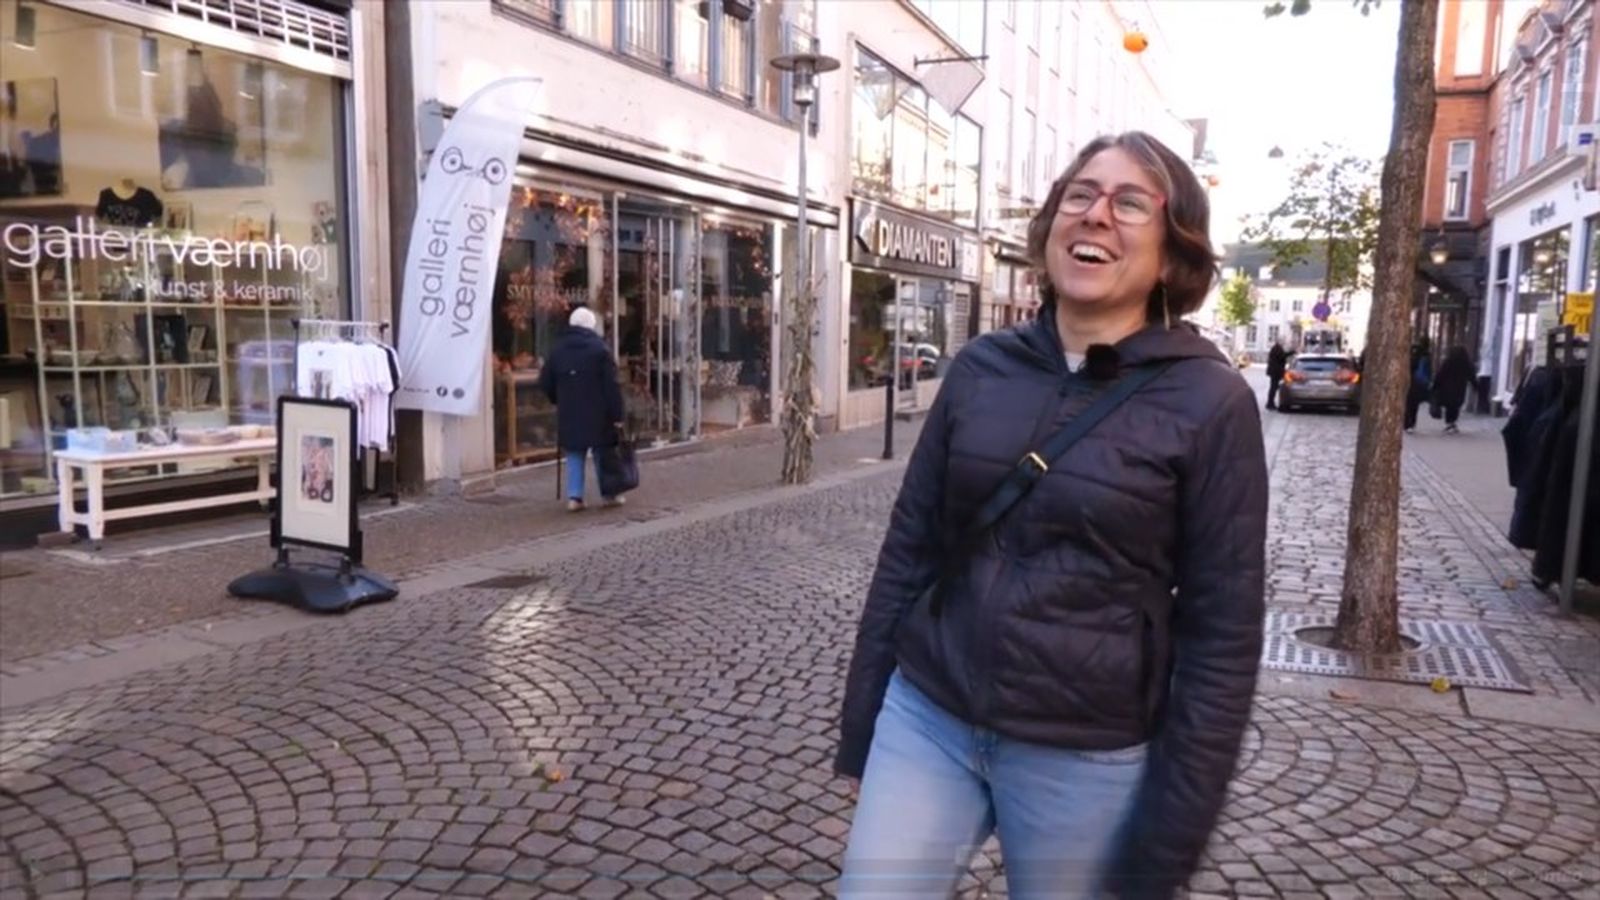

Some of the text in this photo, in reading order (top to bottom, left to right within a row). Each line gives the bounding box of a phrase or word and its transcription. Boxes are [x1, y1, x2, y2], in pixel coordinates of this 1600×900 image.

[4, 215, 328, 282] galleri værnhøj
[418, 218, 452, 316] galleri
[450, 203, 497, 338] værnhøj
[878, 219, 953, 268] DIAMANTEN
[149, 277, 313, 301] kunst & keramik
